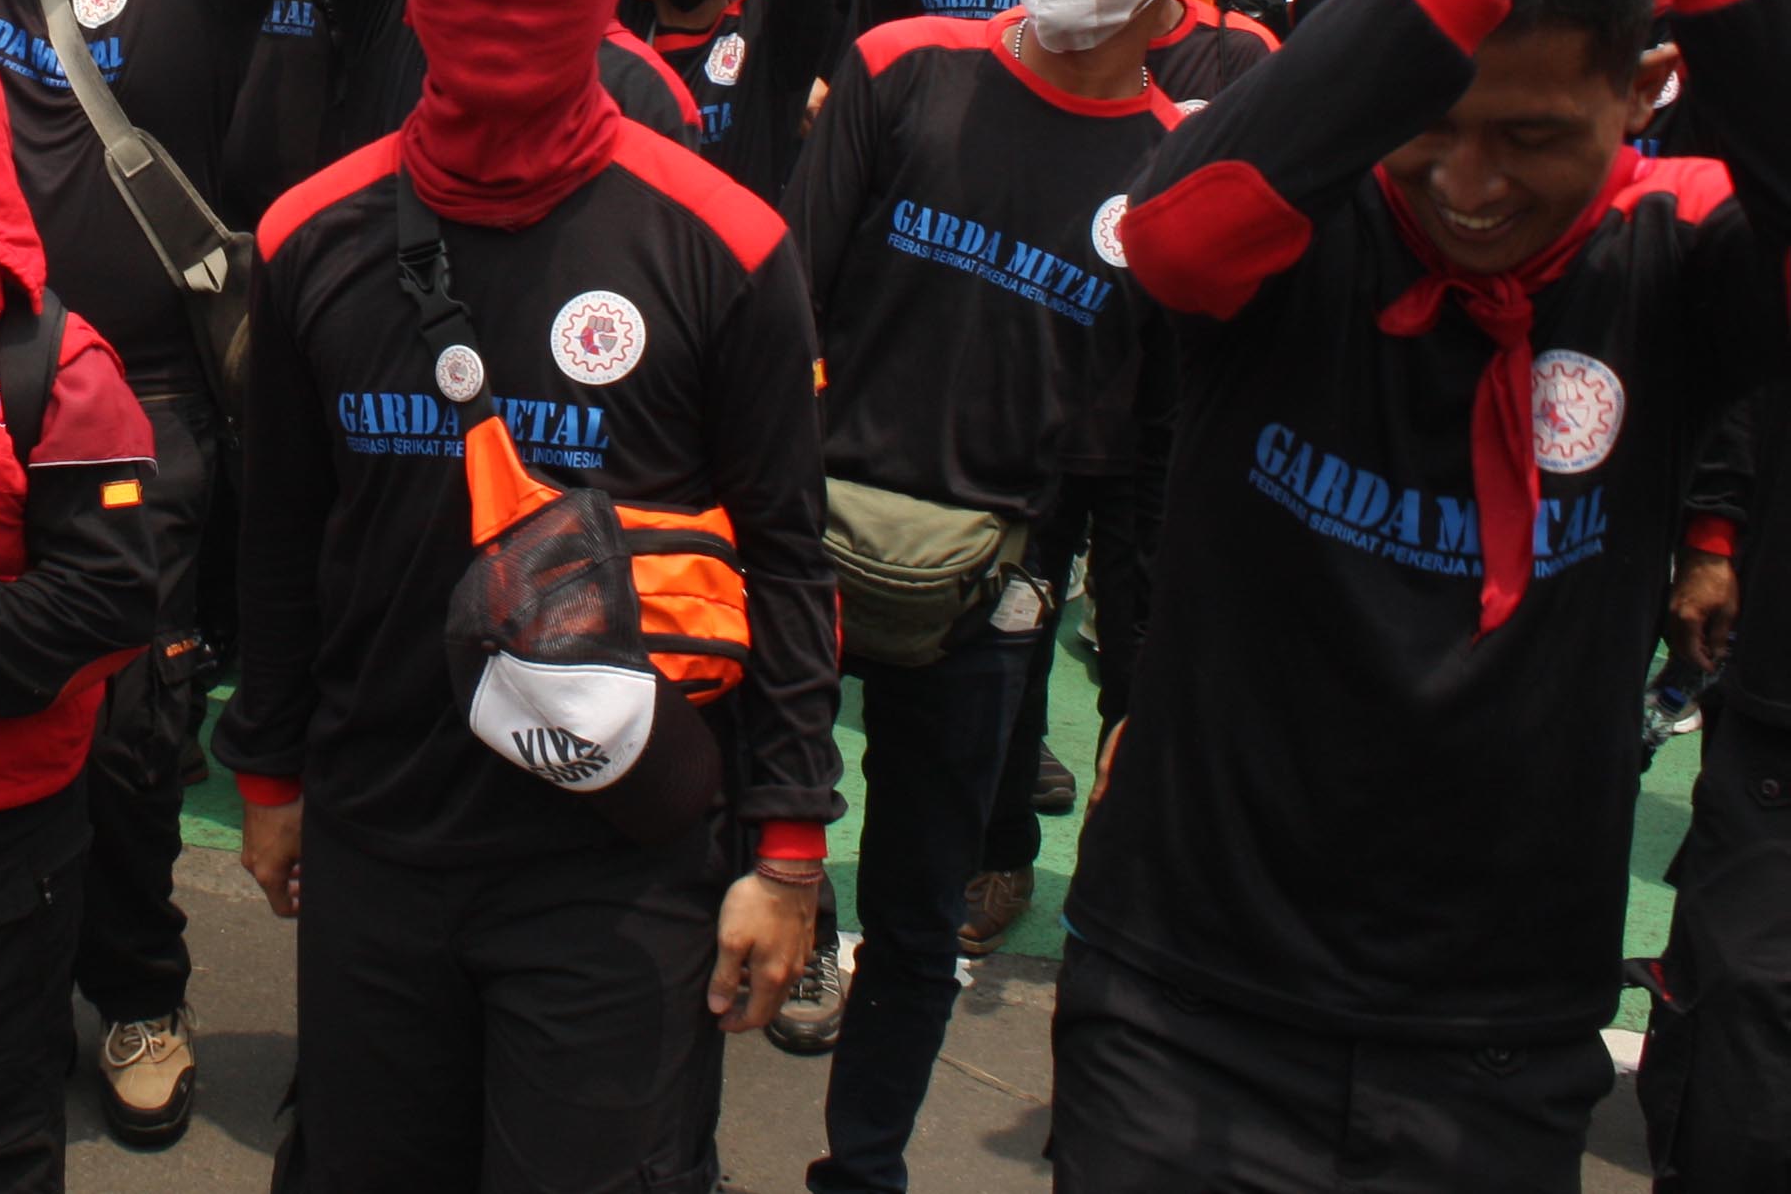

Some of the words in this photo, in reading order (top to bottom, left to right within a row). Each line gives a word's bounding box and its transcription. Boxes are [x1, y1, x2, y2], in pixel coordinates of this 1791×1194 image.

[893, 199, 1002, 264] GARDA
[932, 250, 977, 274] SERIKAT
[338, 391, 459, 436] GARDA
[393, 437, 441, 456] SERIKAT
[531, 448, 604, 470] INDONESIA
[1255, 421, 1422, 546] GARDA
[1435, 485, 1608, 557] MTAL
[1309, 512, 1379, 557] SERIKAT
[1382, 538, 1469, 577] PEKERJA
